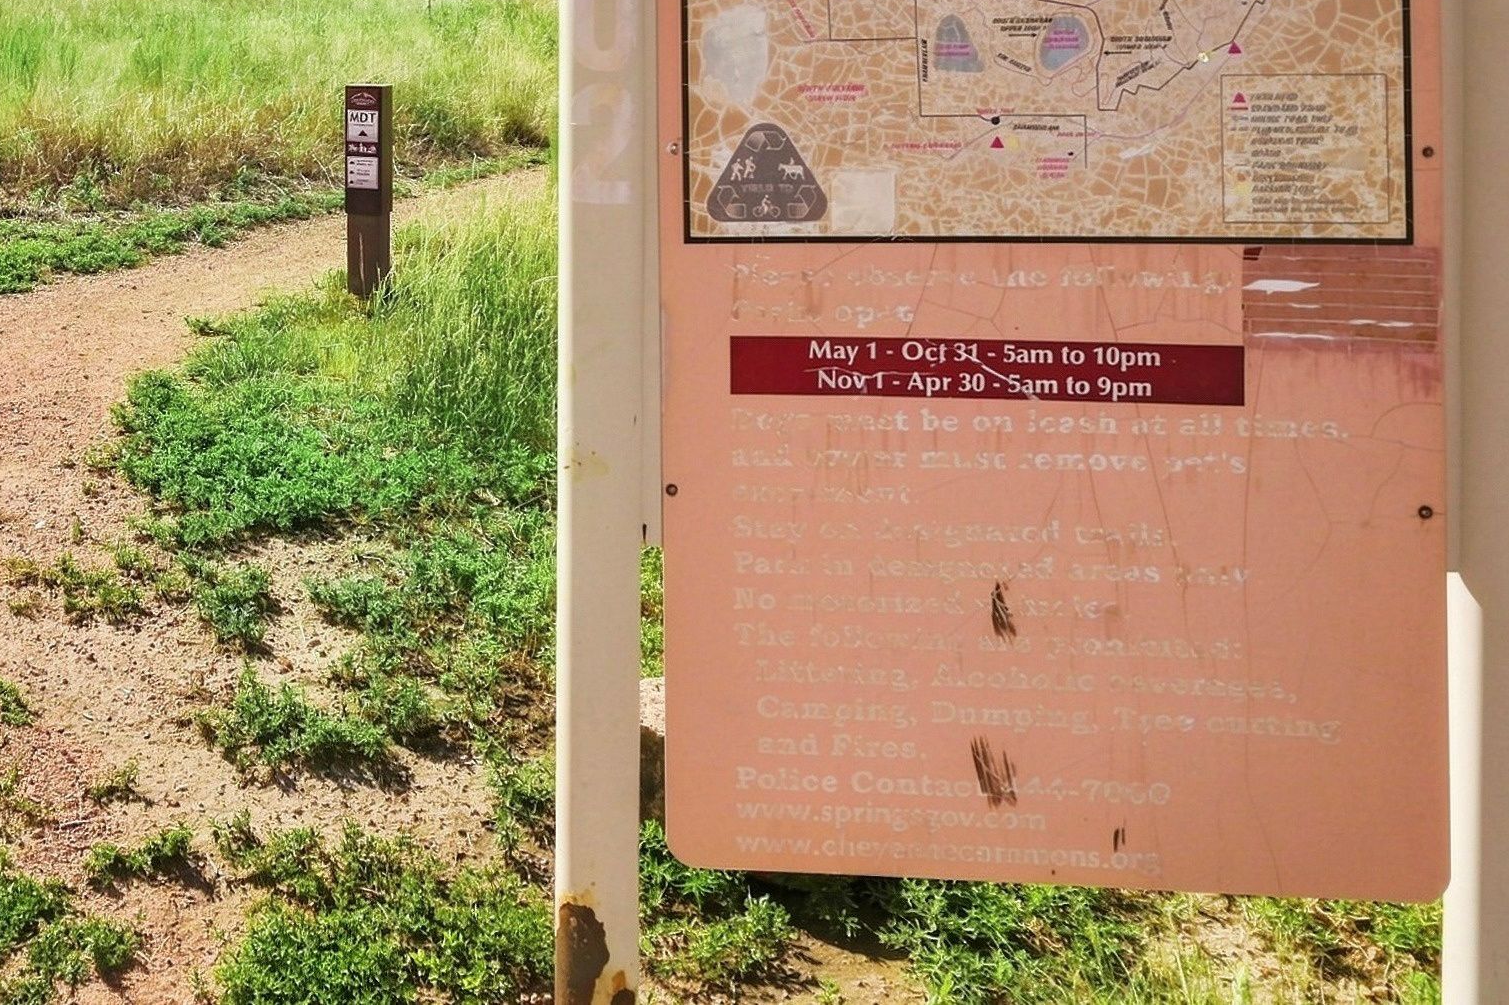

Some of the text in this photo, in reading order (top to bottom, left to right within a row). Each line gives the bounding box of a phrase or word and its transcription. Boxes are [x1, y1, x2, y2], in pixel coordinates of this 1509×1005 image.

[349, 112, 376, 123] MDT
[809, 341, 858, 364] May
[866, 341, 877, 359] 1
[902, 341, 947, 362] Oct
[954, 342, 978, 361] 31
[1003, 344, 1054, 363] 5am
[1061, 346, 1085, 365] to
[1093, 347, 1161, 371] 10pm
[818, 370, 867, 390] Nov
[873, 371, 884, 389] 1
[907, 372, 953, 396] Apr
[958, 372, 985, 392] 30
[1008, 374, 1058, 394] 5am
[1065, 376, 1090, 395] to
[1097, 377, 1152, 401] 9pm
[921, 410, 958, 431] be
[972, 415, 1013, 432] on
[1131, 415, 1166, 435] at
[733, 588, 777, 611] No
[755, 695, 918, 730] Camping,
[735, 768, 839, 793] Police
